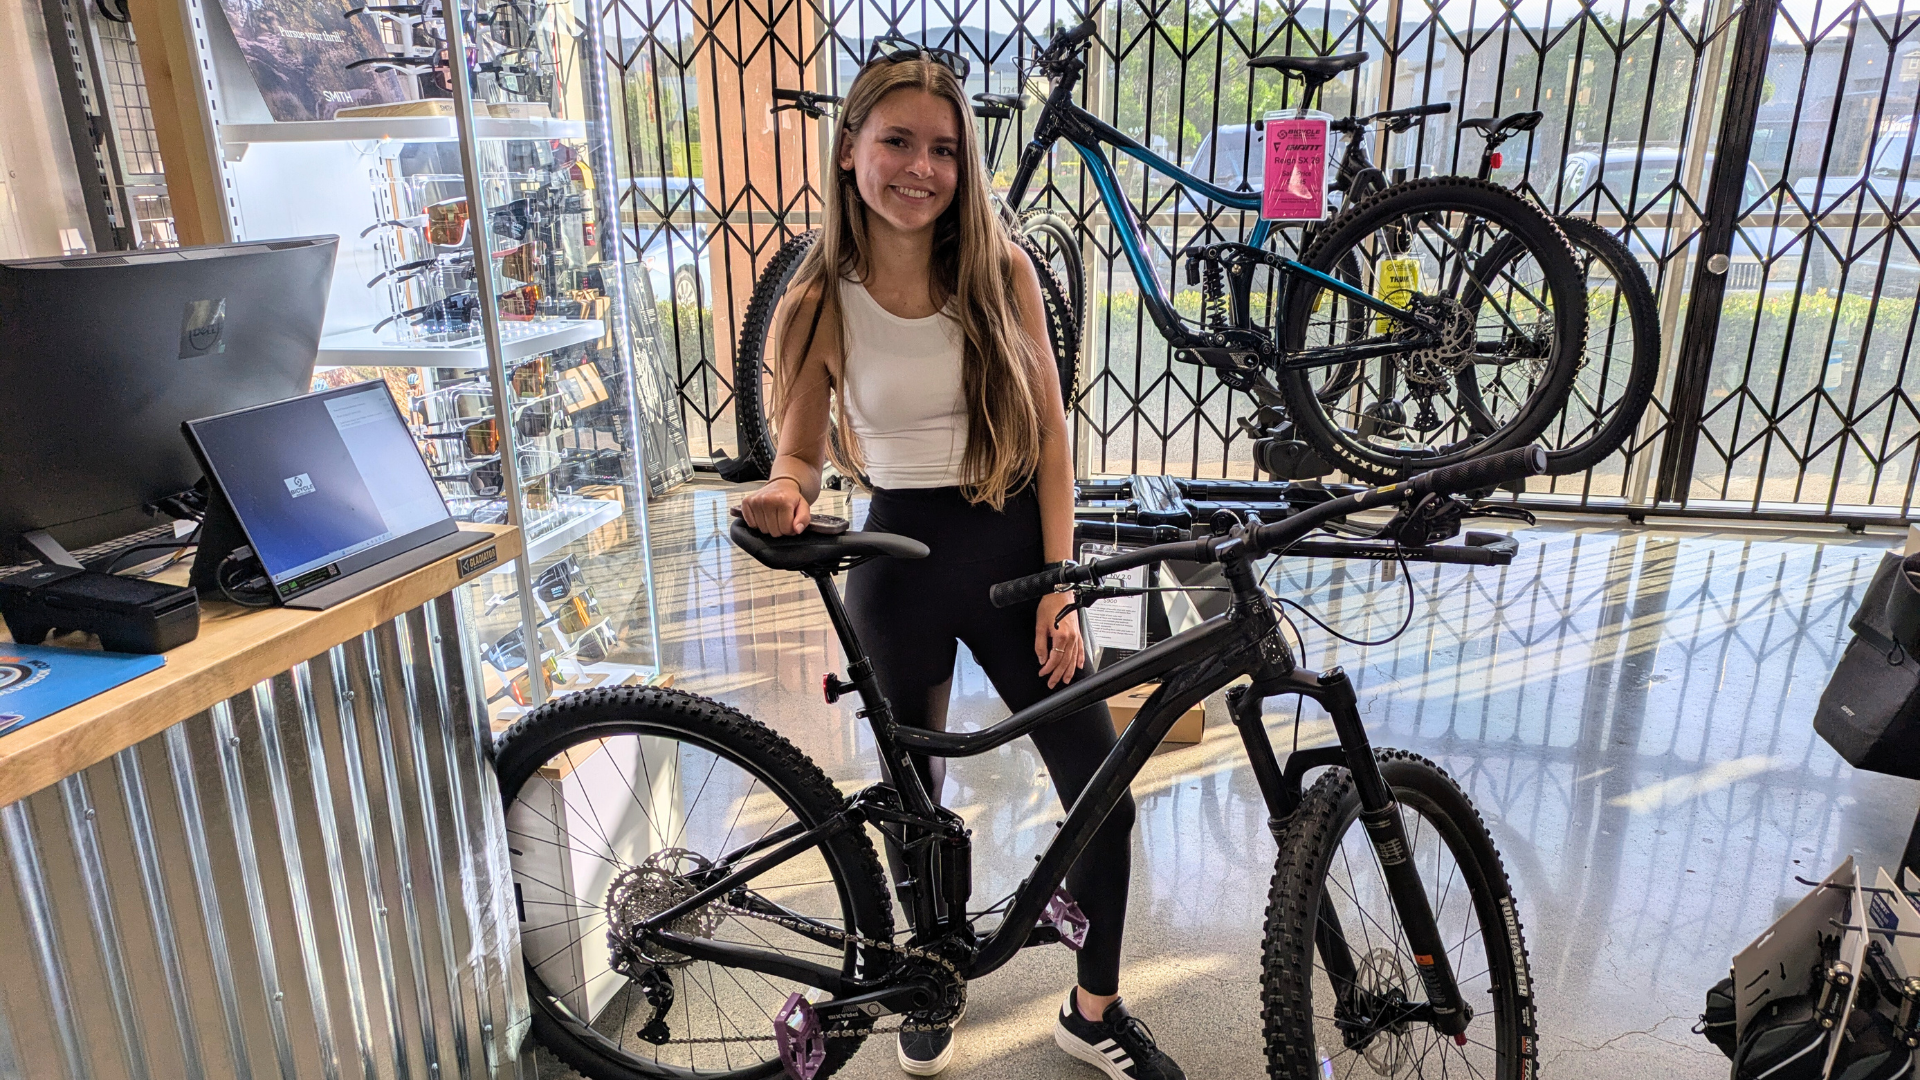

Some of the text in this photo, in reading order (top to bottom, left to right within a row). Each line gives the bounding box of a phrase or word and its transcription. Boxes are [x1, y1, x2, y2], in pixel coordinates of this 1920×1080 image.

[277, 25, 344, 43] Pursue your thrill.
[323, 90, 353, 102] SMITH
[1274, 157, 1296, 166] Reign
[1298, 156, 1309, 164] SX
[1041, 287, 1066, 358] MAXXIS
[1332, 443, 1398, 477] MAXXIS
[290, 483, 314, 495] BICYCLE
[469, 548, 496, 568] GLADIATOR
[1122, 573, 1132, 581] 2.0
[1499, 896, 1529, 997] FOREKASTER
[827, 1012, 860, 1020] PRAXIS
